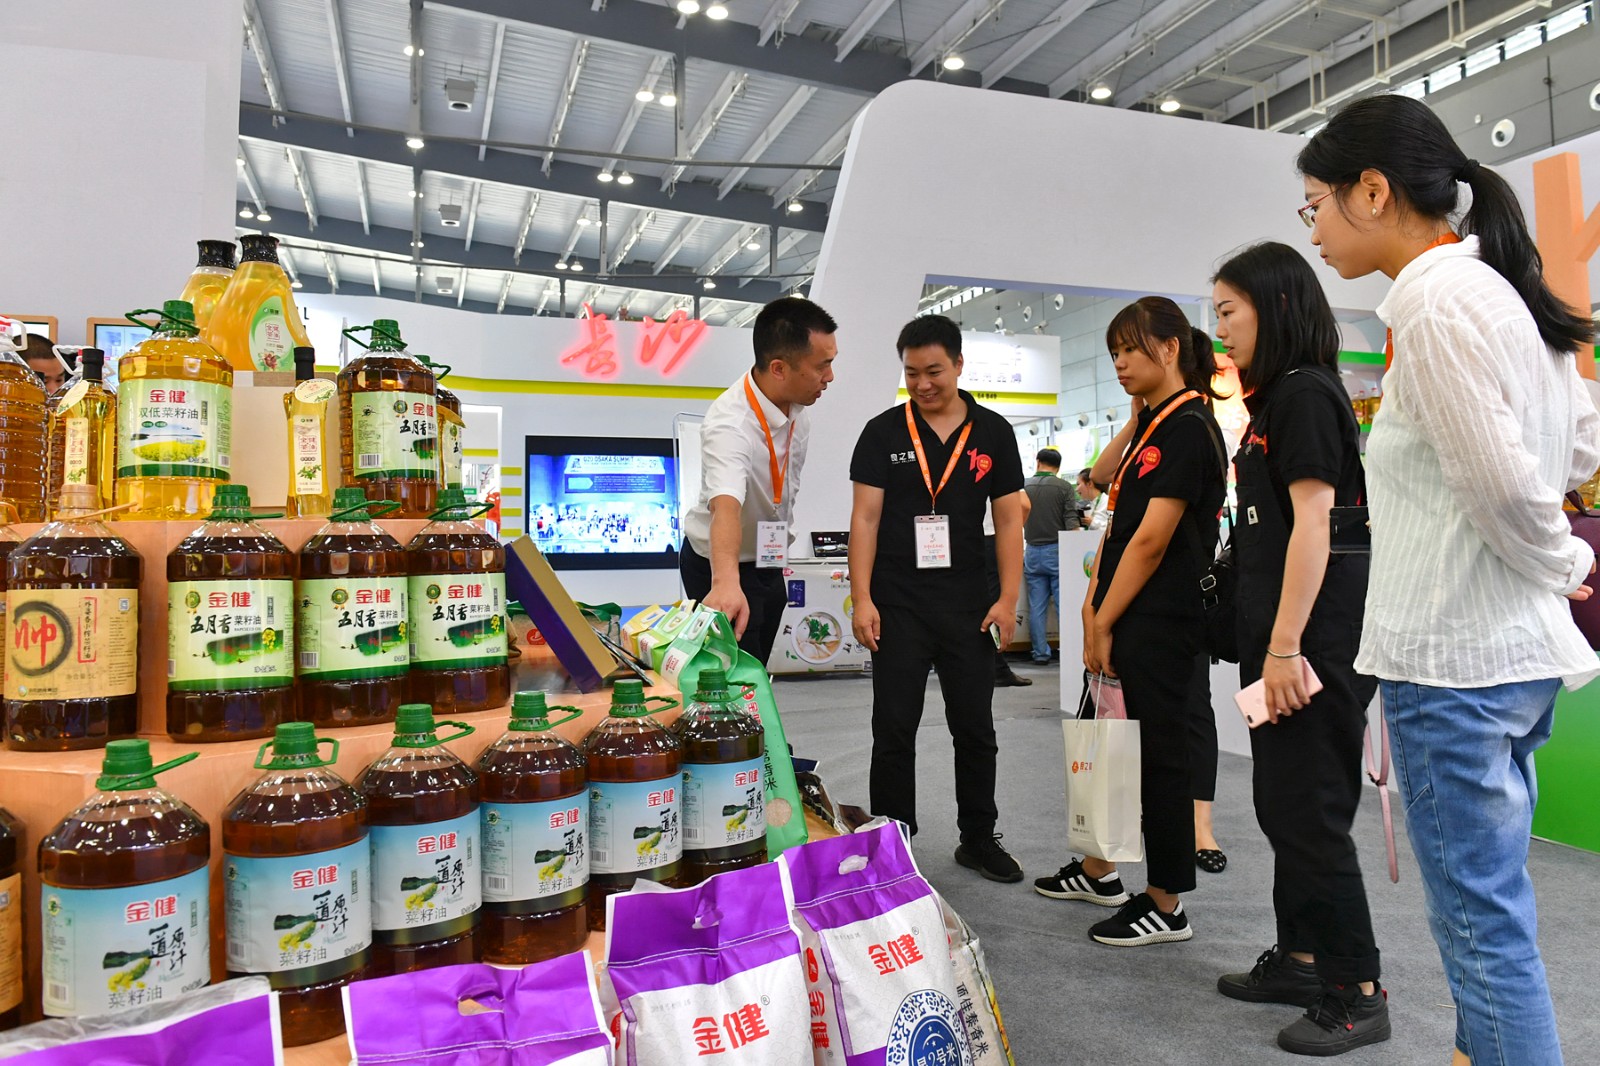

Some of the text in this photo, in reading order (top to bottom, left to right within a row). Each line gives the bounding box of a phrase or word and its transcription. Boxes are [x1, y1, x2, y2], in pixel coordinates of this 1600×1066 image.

[150, 389, 186, 404] 金健
[139, 407, 199, 420] 双低菜籽油
[208, 591, 252, 608] 金健
[355, 589, 391, 604] 金健
[447, 584, 483, 599] 金健
[338, 609, 377, 628] 五月香
[432, 603, 468, 621] 五月香
[190, 614, 261, 634] 五月香 菜籽油
[647, 788, 674, 807] 金健
[550, 808, 579, 829] 金健
[417, 832, 457, 854] 金健
[637, 852, 668, 868] 菜籽油
[292, 865, 338, 890] 金健
[538, 876, 573, 894] 菜籽油
[126, 896, 178, 924] 金健
[405, 906, 447, 924] 菜籽油
[279, 947, 327, 967] 菜籽油
[868, 933, 924, 976] 金健
[108, 986, 163, 1010] 菜籽油
[691, 1002, 770, 1057] 金健
[807, 990, 831, 1050] 金健
